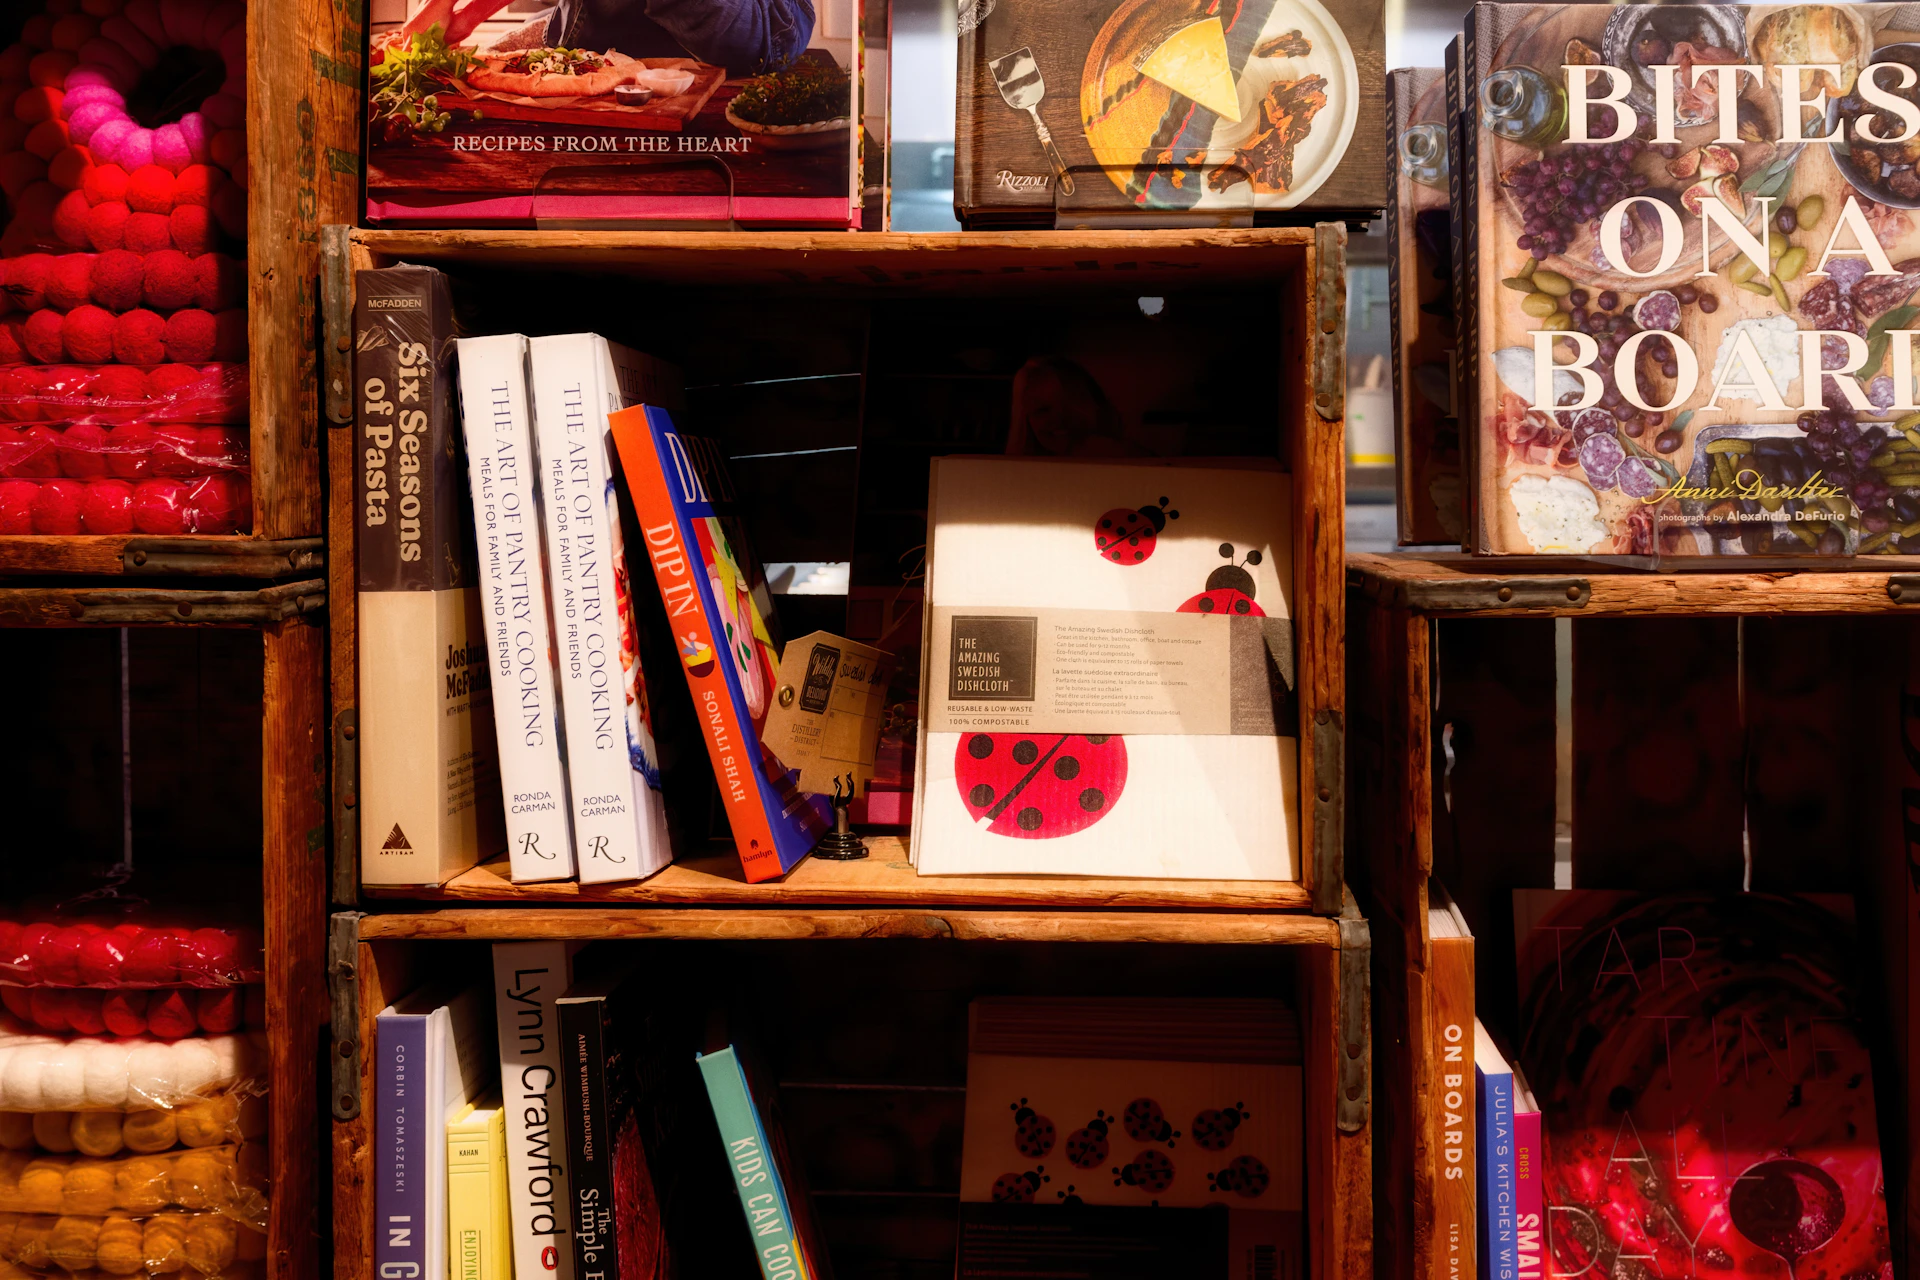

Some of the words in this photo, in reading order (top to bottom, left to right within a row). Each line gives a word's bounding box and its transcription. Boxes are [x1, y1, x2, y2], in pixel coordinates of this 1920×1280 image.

[1466, 39, 1476, 146] BITES
[1560, 62, 1920, 144] BITES
[1448, 68, 1459, 166] BITES
[452, 136, 546, 151] RECIPES
[552, 136, 618, 152] FROM
[624, 136, 671, 152] THE
[676, 136, 752, 152] HEART
[996, 170, 1049, 192] RIZZOLI
[1451, 174, 1461, 224] ON
[1467, 155, 1476, 208] ON
[1387, 198, 1397, 244] ON
[1599, 195, 1776, 278] ON
[1807, 194, 1904, 277] A
[368, 298, 422, 309] McFADDEN
[1454, 263, 1464, 383] BOARD
[1469, 250, 1478, 378] BOARD
[398, 341, 427, 403] Six
[364, 377, 394, 416] of
[491, 381, 512, 432] THE
[563, 383, 585, 434] THE
[365, 423, 394, 528] Pasta
[480, 457, 494, 499] MEALS
[496, 438, 518, 486] ART
[552, 459, 566, 501] MEALS
[568, 441, 590, 488] ART
[399, 409, 428, 563] Seasons
[501, 492, 522, 524] OF
[1641, 475, 1735, 505] Anni
[1736, 468, 1844, 500] Daulter
[485, 504, 496, 531] FOR
[556, 506, 568, 533] FOR
[573, 494, 594, 526] OF
[1659, 512, 1711, 523] photographs
[1713, 513, 1724, 523] by
[1727, 511, 1791, 522] Alexandra
[1795, 511, 1845, 522] DeFurio
[488, 535, 502, 580] FAMILY
[560, 538, 573, 583] FAMILY
[646, 521, 686, 577] DIP
[505, 531, 532, 623] PANTRY
[577, 533, 603, 626] PANTRY
[663, 580, 699, 618] IN
[493, 586, 505, 616] AND
[564, 588, 576, 619] AND
[496, 621, 512, 677] FRIENDS
[567, 624, 582, 679] FRIENDS
[959, 638, 977, 649] THE
[1068, 626, 1096, 634] Amazing
[957, 666, 1000, 677] SWEDISH
[958, 652, 1000, 663] AMAZING
[1056, 649, 1088, 657] Eco-friendly
[515, 630, 543, 747] COOKING
[586, 633, 614, 750] COOKING
[792, 723, 822, 738] DISTILLERY
[972, 718, 1029, 726] COMPOSTABLE
[702, 690, 731, 753] SONALI
[722, 755, 746, 803] SHAH
[511, 802, 556, 814] CARMAN
[513, 791, 552, 802] RONDA
[580, 805, 626, 817] CARMAN
[583, 794, 622, 806] RONDA
[518, 832, 557, 860] R
[587, 835, 626, 864] R
[742, 849, 773, 863] hamlyn
[1532, 926, 1700, 992] TAR
[507, 967, 549, 1055] Lynn
[577, 1033, 589, 1065] AIMÉE
[1444, 1024, 1462, 1062] ON
[1640, 1015, 1849, 1085] TINE
[396, 1044, 405, 1097] CORBIN
[580, 1066, 593, 1162] WIMBUSH-BOURQUE
[1444, 1074, 1462, 1180] BOARDS
[1494, 1086, 1508, 1156] JULIA'S
[395, 1107, 405, 1193] TOMASZESKI
[459, 1149, 479, 1157] KAHAN
[521, 1064, 567, 1237] Crawford
[730, 1135, 767, 1188] KIDS
[1519, 1147, 1529, 1179] CROSS
[1604, 1110, 1765, 1180] ALL
[597, 1207, 611, 1235] The
[747, 1193, 783, 1237] CAN
[1497, 1163, 1511, 1242] KITCHEN
[388, 1215, 411, 1247] IN
[575, 1188, 605, 1264] Simple
[1450, 1223, 1459, 1251] LISA
[1548, 1206, 1726, 1279] DAY
[380, 1261, 420, 1279] G
[1500, 1248, 1512, 1280] WIS
